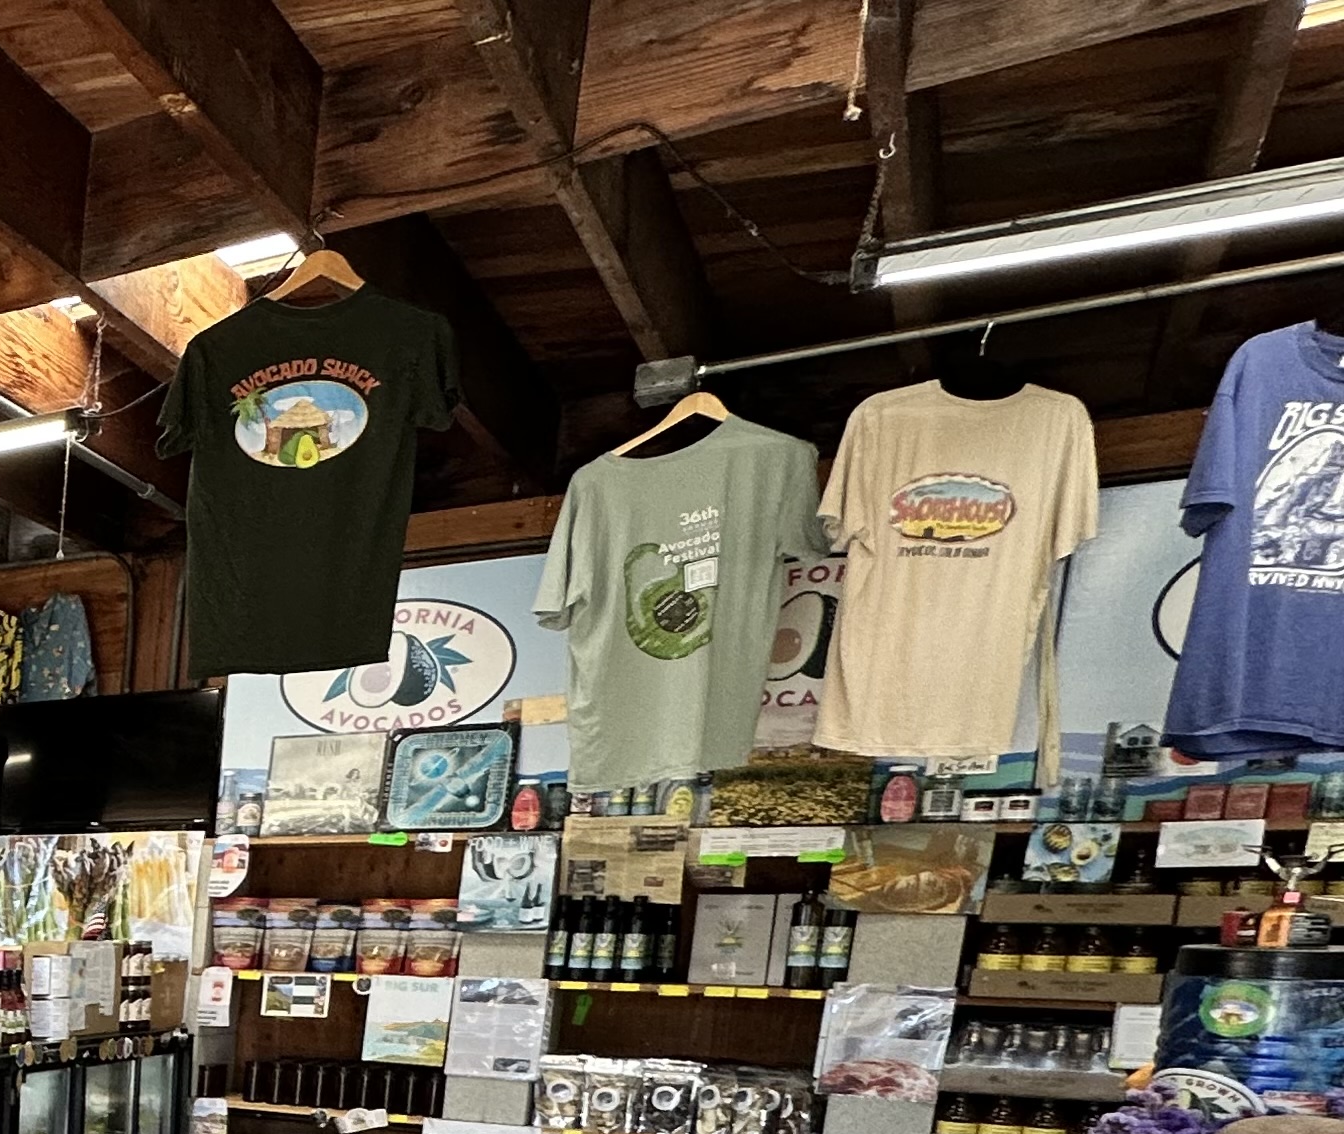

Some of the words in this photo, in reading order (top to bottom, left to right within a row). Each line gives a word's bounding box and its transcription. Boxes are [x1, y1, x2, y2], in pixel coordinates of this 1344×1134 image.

[230, 358, 317, 400] AVOCADO
[319, 358, 382, 396] SHACK
[1269, 401, 1333, 450] BIG
[679, 506, 719, 526] 36th
[658, 531, 720, 553] Avocado
[664, 542, 720, 565] Festival
[1248, 571, 1309, 588] RVIVED
[394, 607, 477, 636] ORNIA
[320, 699, 463, 731] AVOCADOS
[384, 979, 408, 992] BIG
[411, 981, 439, 993] SUR
[1185, 1077, 1241, 1104] GROWN
